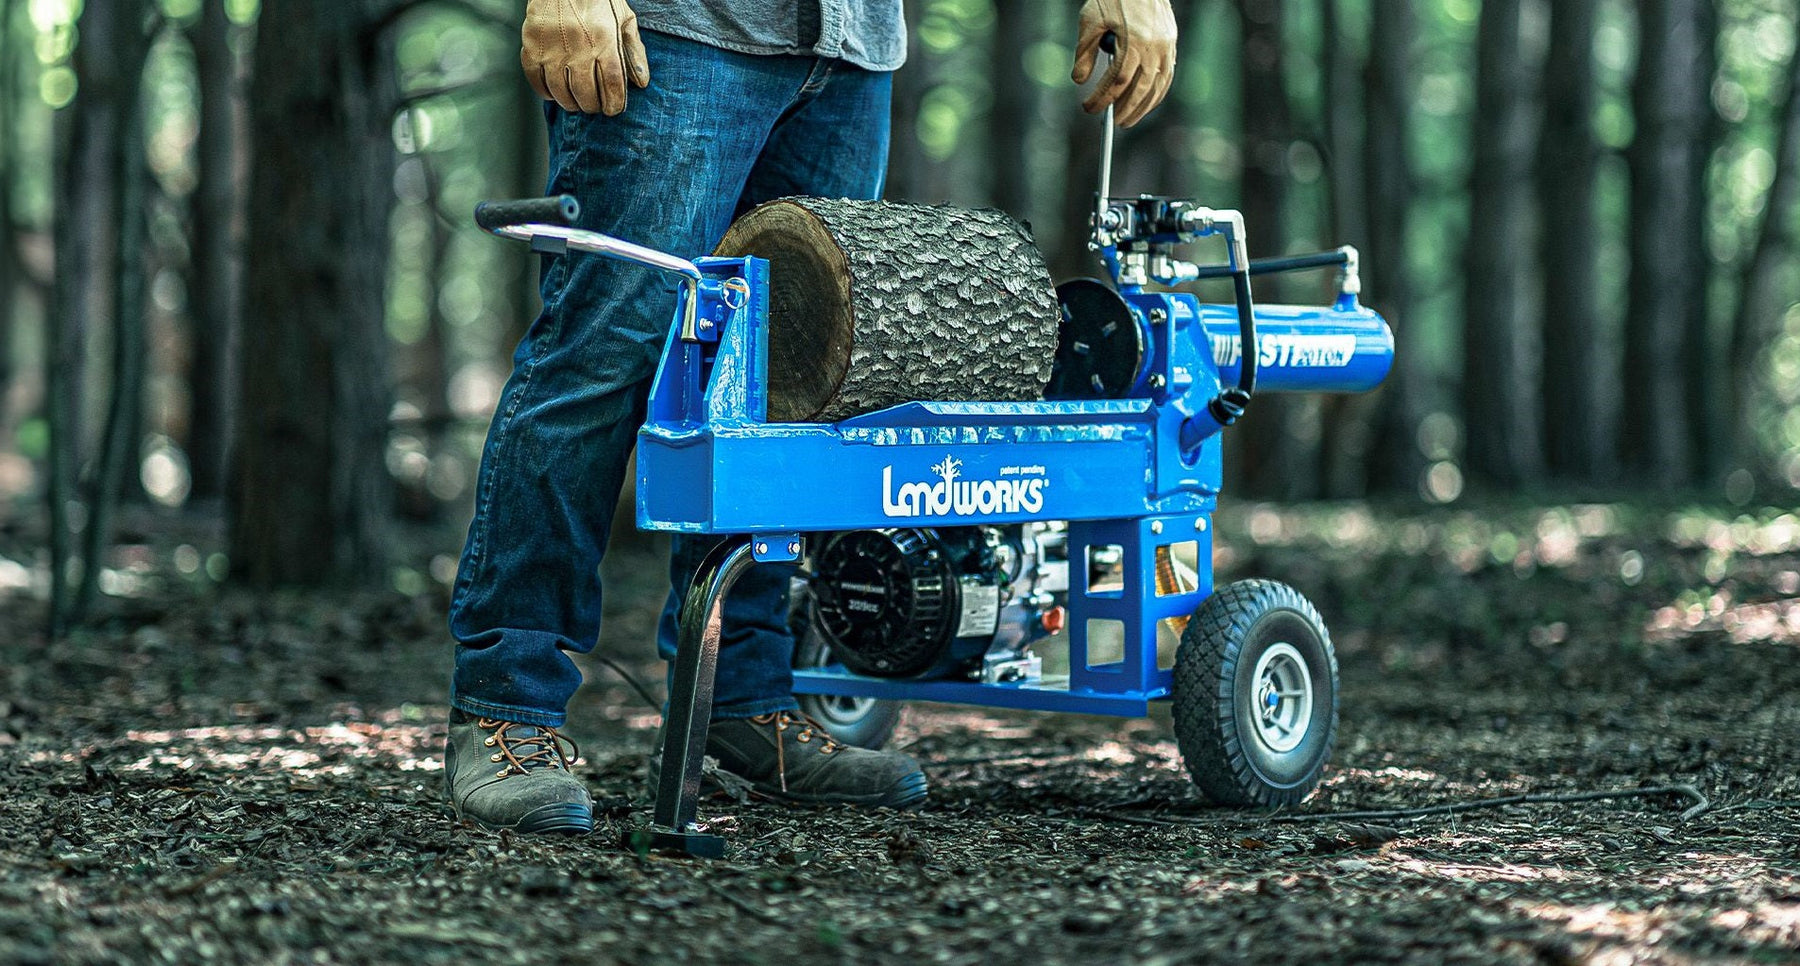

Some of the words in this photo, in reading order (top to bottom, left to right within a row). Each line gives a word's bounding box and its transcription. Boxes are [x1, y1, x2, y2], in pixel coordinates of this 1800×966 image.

[1228, 334, 1297, 367] FST
[1000, 466, 1020, 476] patent
[1020, 465, 1045, 476] pending
